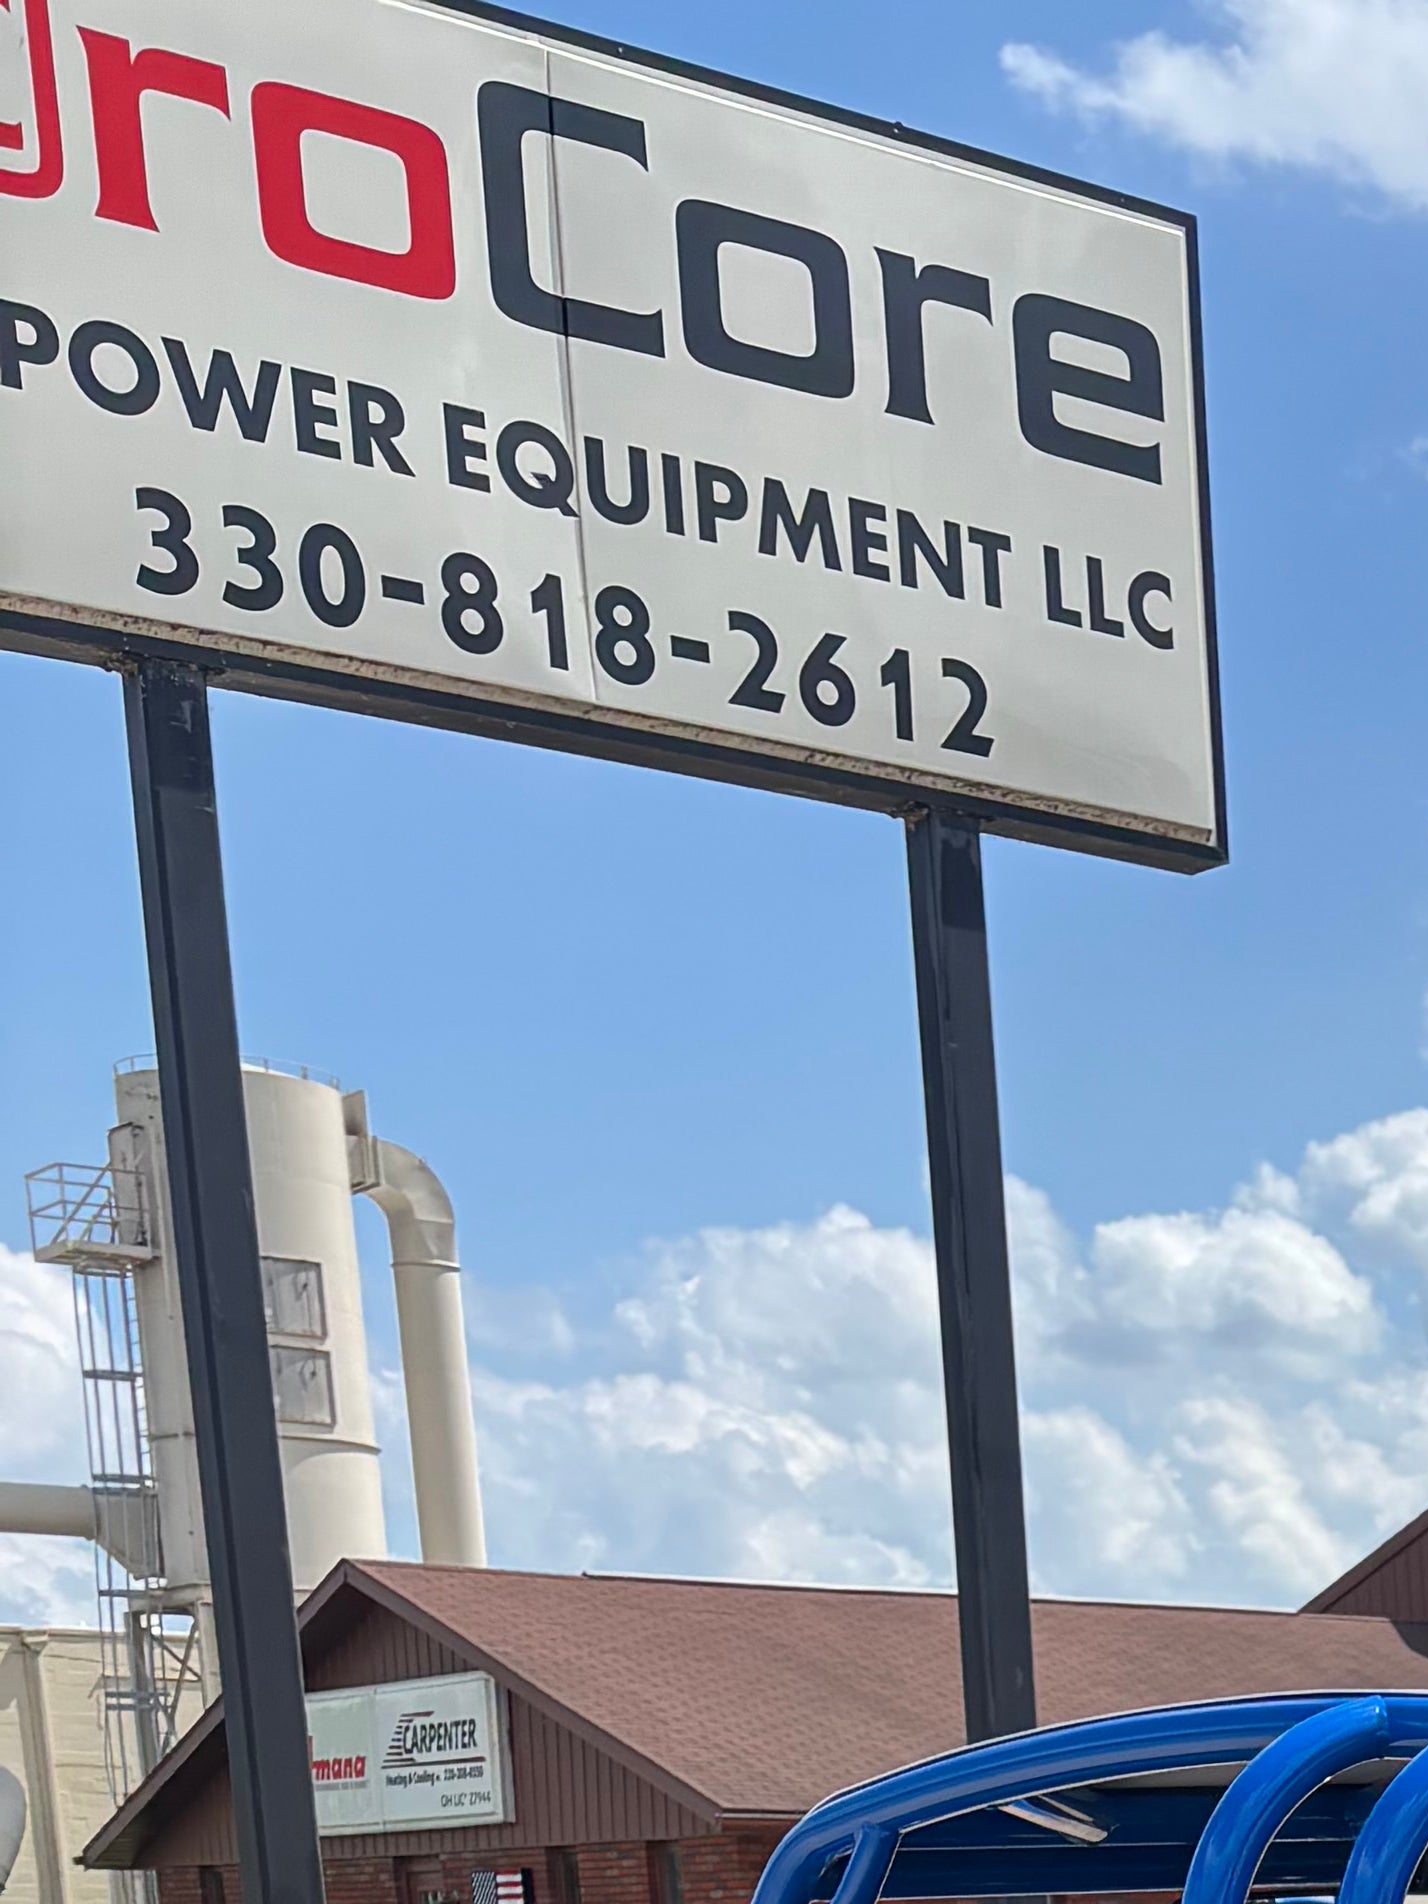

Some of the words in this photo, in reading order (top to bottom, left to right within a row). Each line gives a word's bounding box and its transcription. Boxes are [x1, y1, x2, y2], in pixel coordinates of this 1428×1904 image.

[0, 298, 415, 476] POWER
[444, 401, 1011, 612] EQUIPMENT
[1043, 544, 1175, 651] LLC
[135, 486, 995, 758] 330-818-2612
[307, 1735, 367, 1781] mana
[402, 1718, 477, 1755] CARPENTER
